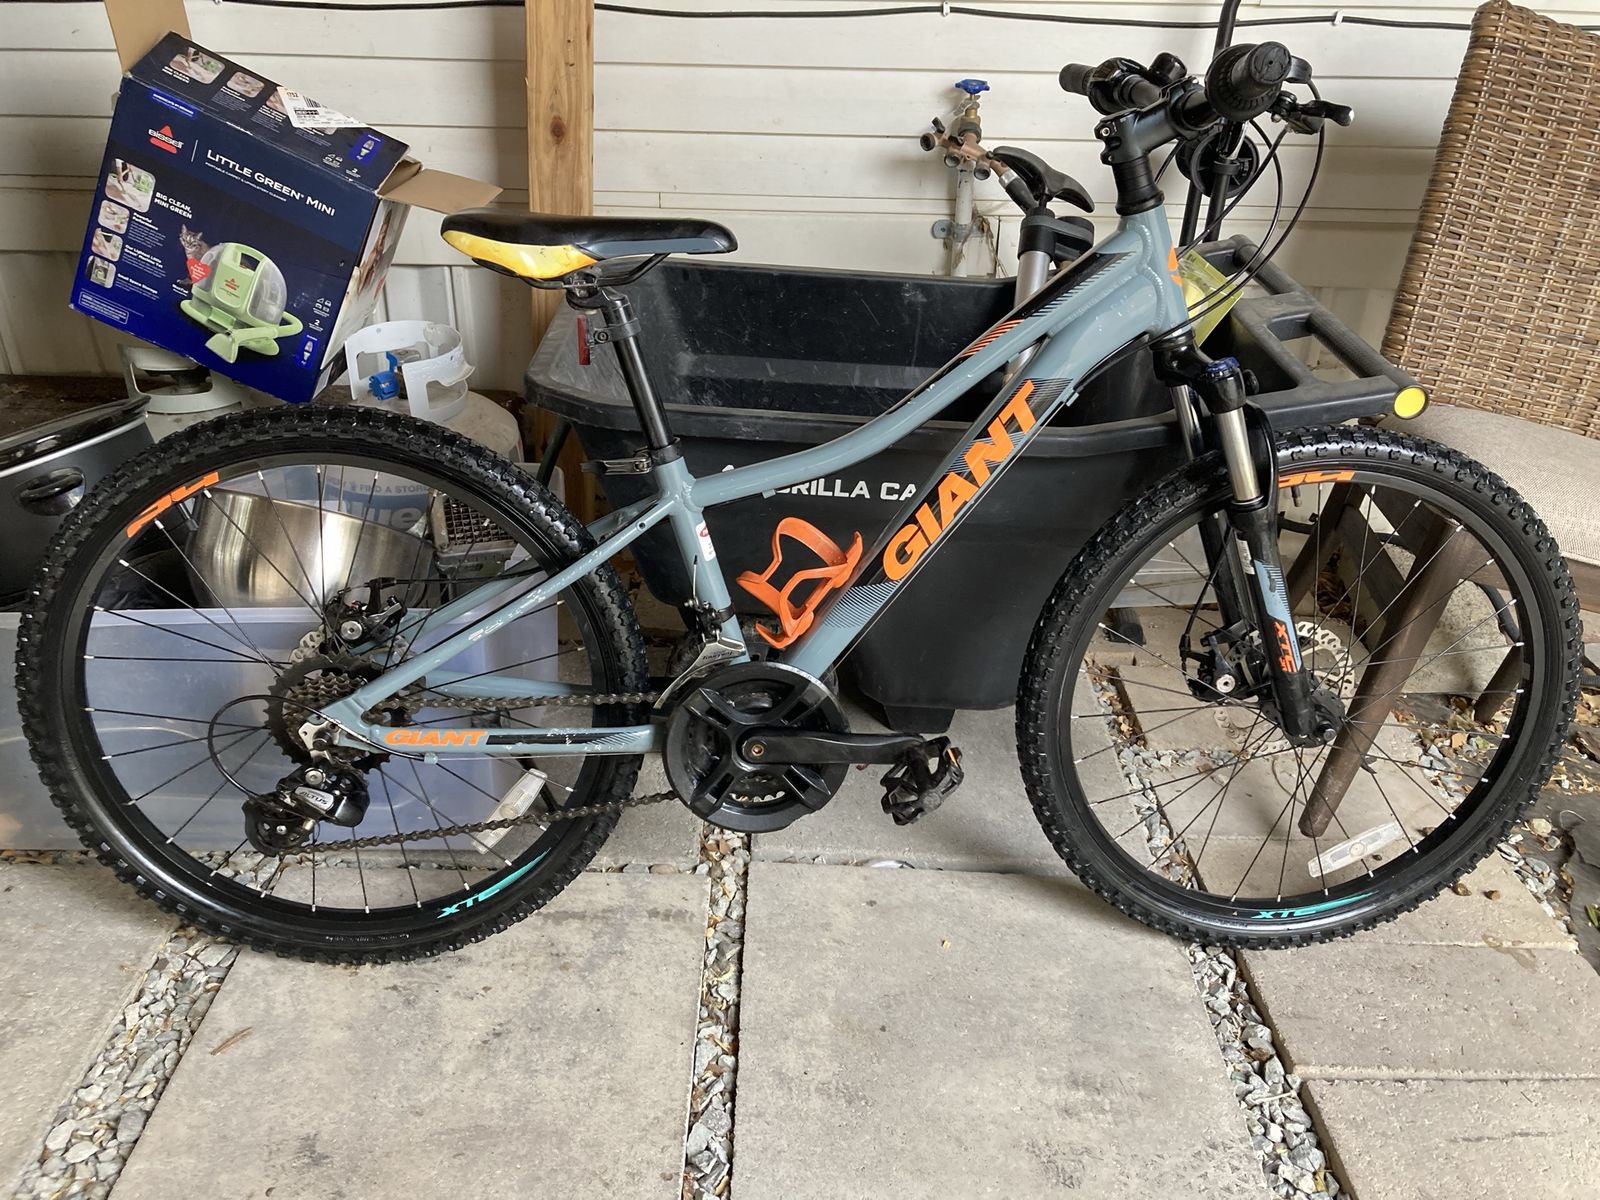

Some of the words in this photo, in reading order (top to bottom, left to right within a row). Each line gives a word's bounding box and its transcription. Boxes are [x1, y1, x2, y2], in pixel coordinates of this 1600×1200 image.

[206, 149, 253, 178] LITTLE
[306, 196, 335, 217] MINI
[155, 191, 168, 201] BIG
[154, 198, 169, 208] MINI
[169, 205, 193, 219] GREEN
[776, 478, 871, 499] RILLA
[880, 481, 917, 500] CA
[883, 379, 1037, 582] GIANT
[384, 729, 488, 746] GIANT
[300, 790, 328, 805] ALTUS
